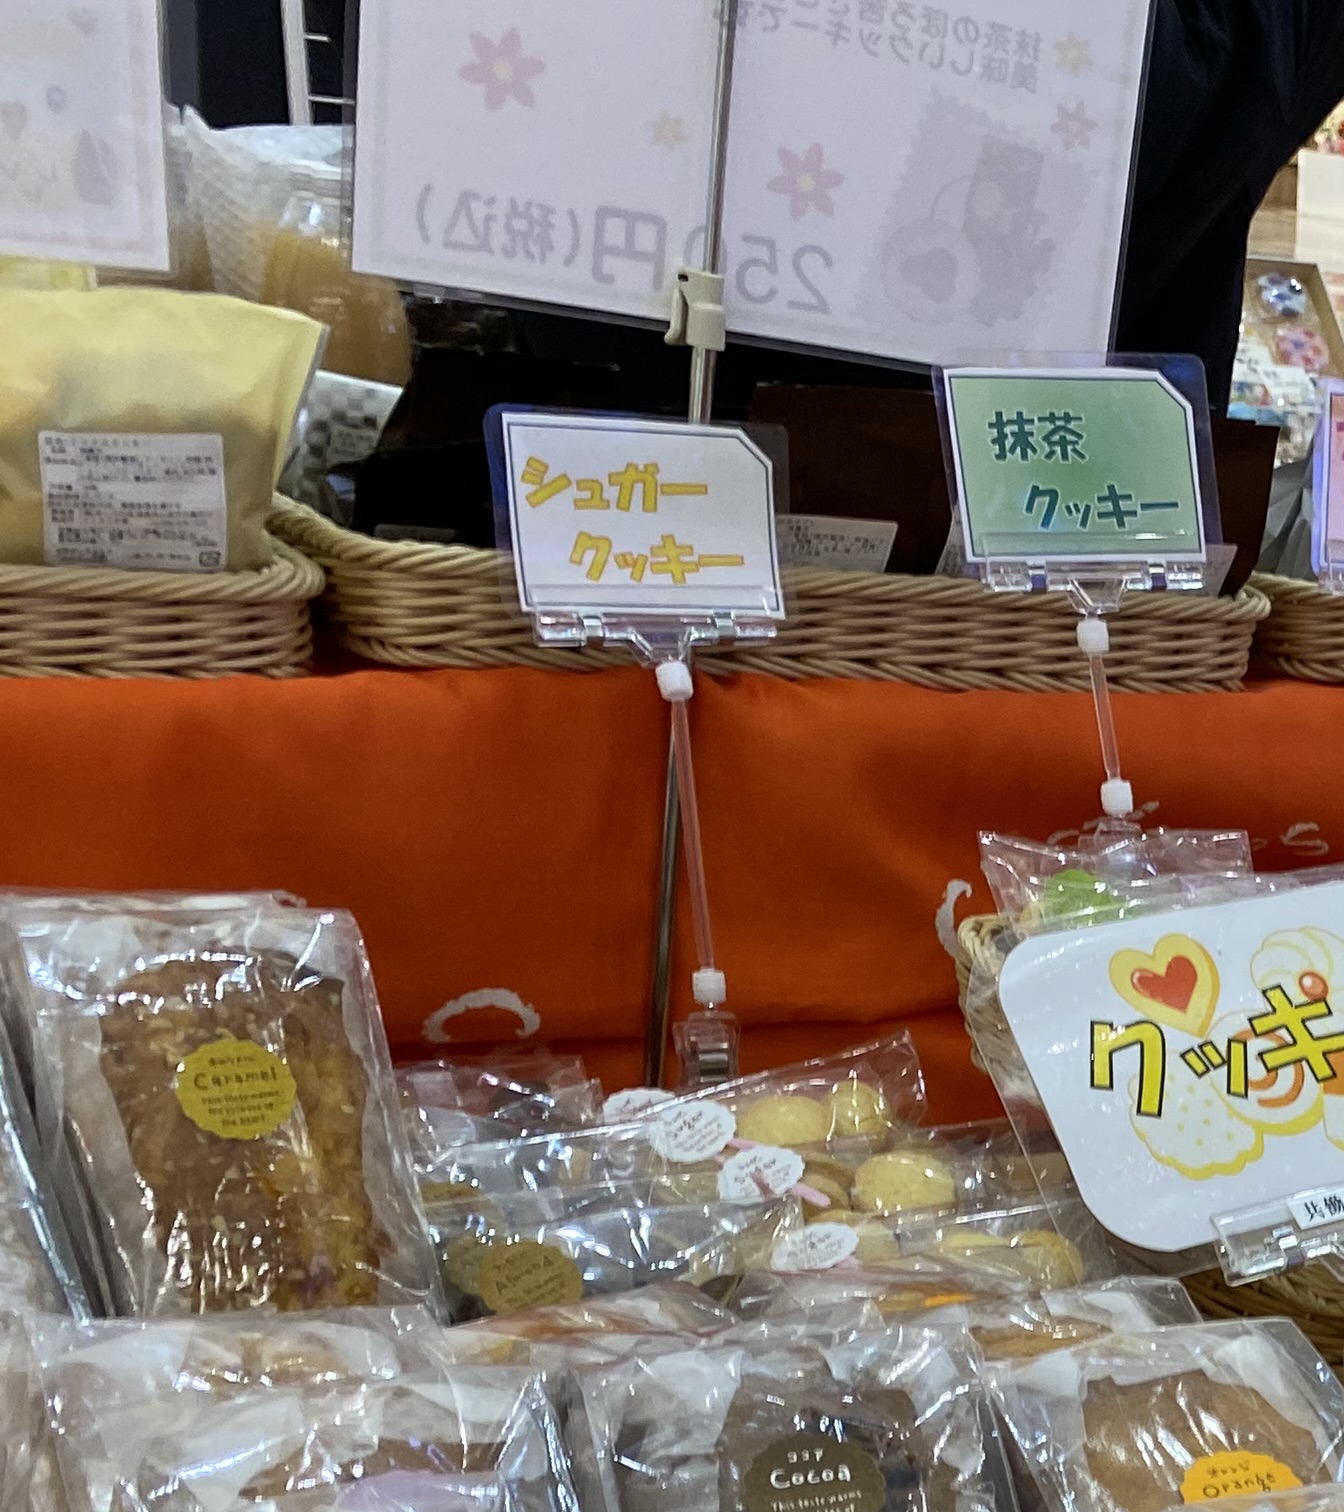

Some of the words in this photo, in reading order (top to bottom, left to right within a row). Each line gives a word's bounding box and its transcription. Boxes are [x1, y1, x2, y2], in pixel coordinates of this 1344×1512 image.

[987, 409, 1087, 466] 抹茶
[520, 456, 708, 514] シュガー
[1023, 484, 1180, 532] クッキー
[569, 530, 744, 585] クッキー
[194, 1066, 277, 1090] Caramel
[770, 1464, 851, 1489] Cocoa
